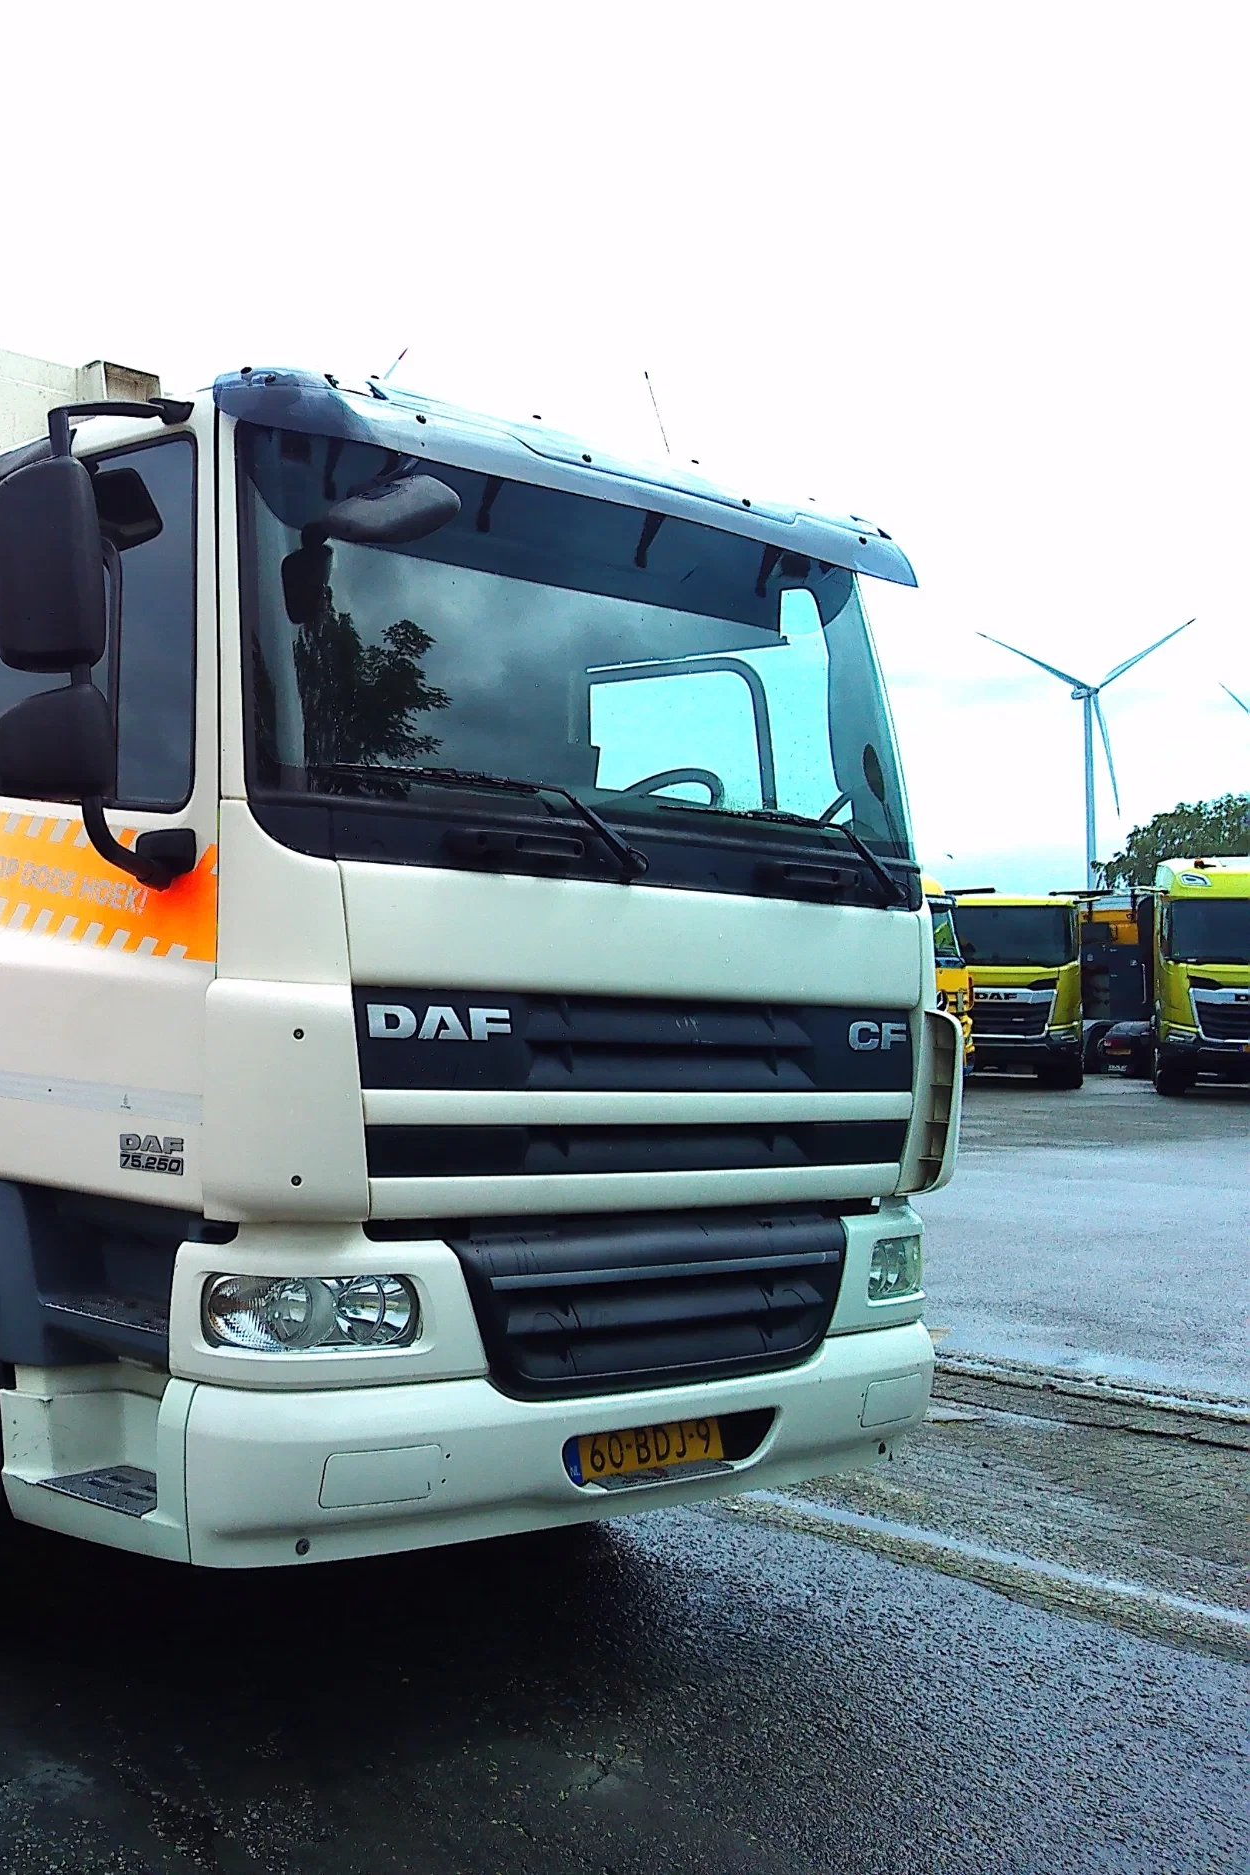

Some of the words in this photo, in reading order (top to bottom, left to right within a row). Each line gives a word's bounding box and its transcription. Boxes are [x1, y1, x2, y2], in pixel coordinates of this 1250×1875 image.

[20, 861, 78, 897] DODE
[78, 876, 150, 916] HOEK!
[975, 992, 1018, 1001] DAF
[366, 1003, 512, 1041] DAF
[848, 1020, 907, 1051] CF
[120, 1133, 184, 1154] DAF
[120, 1153, 181, 1172] 75.250
[589, 1416, 711, 1472] 60-BDJ-9
